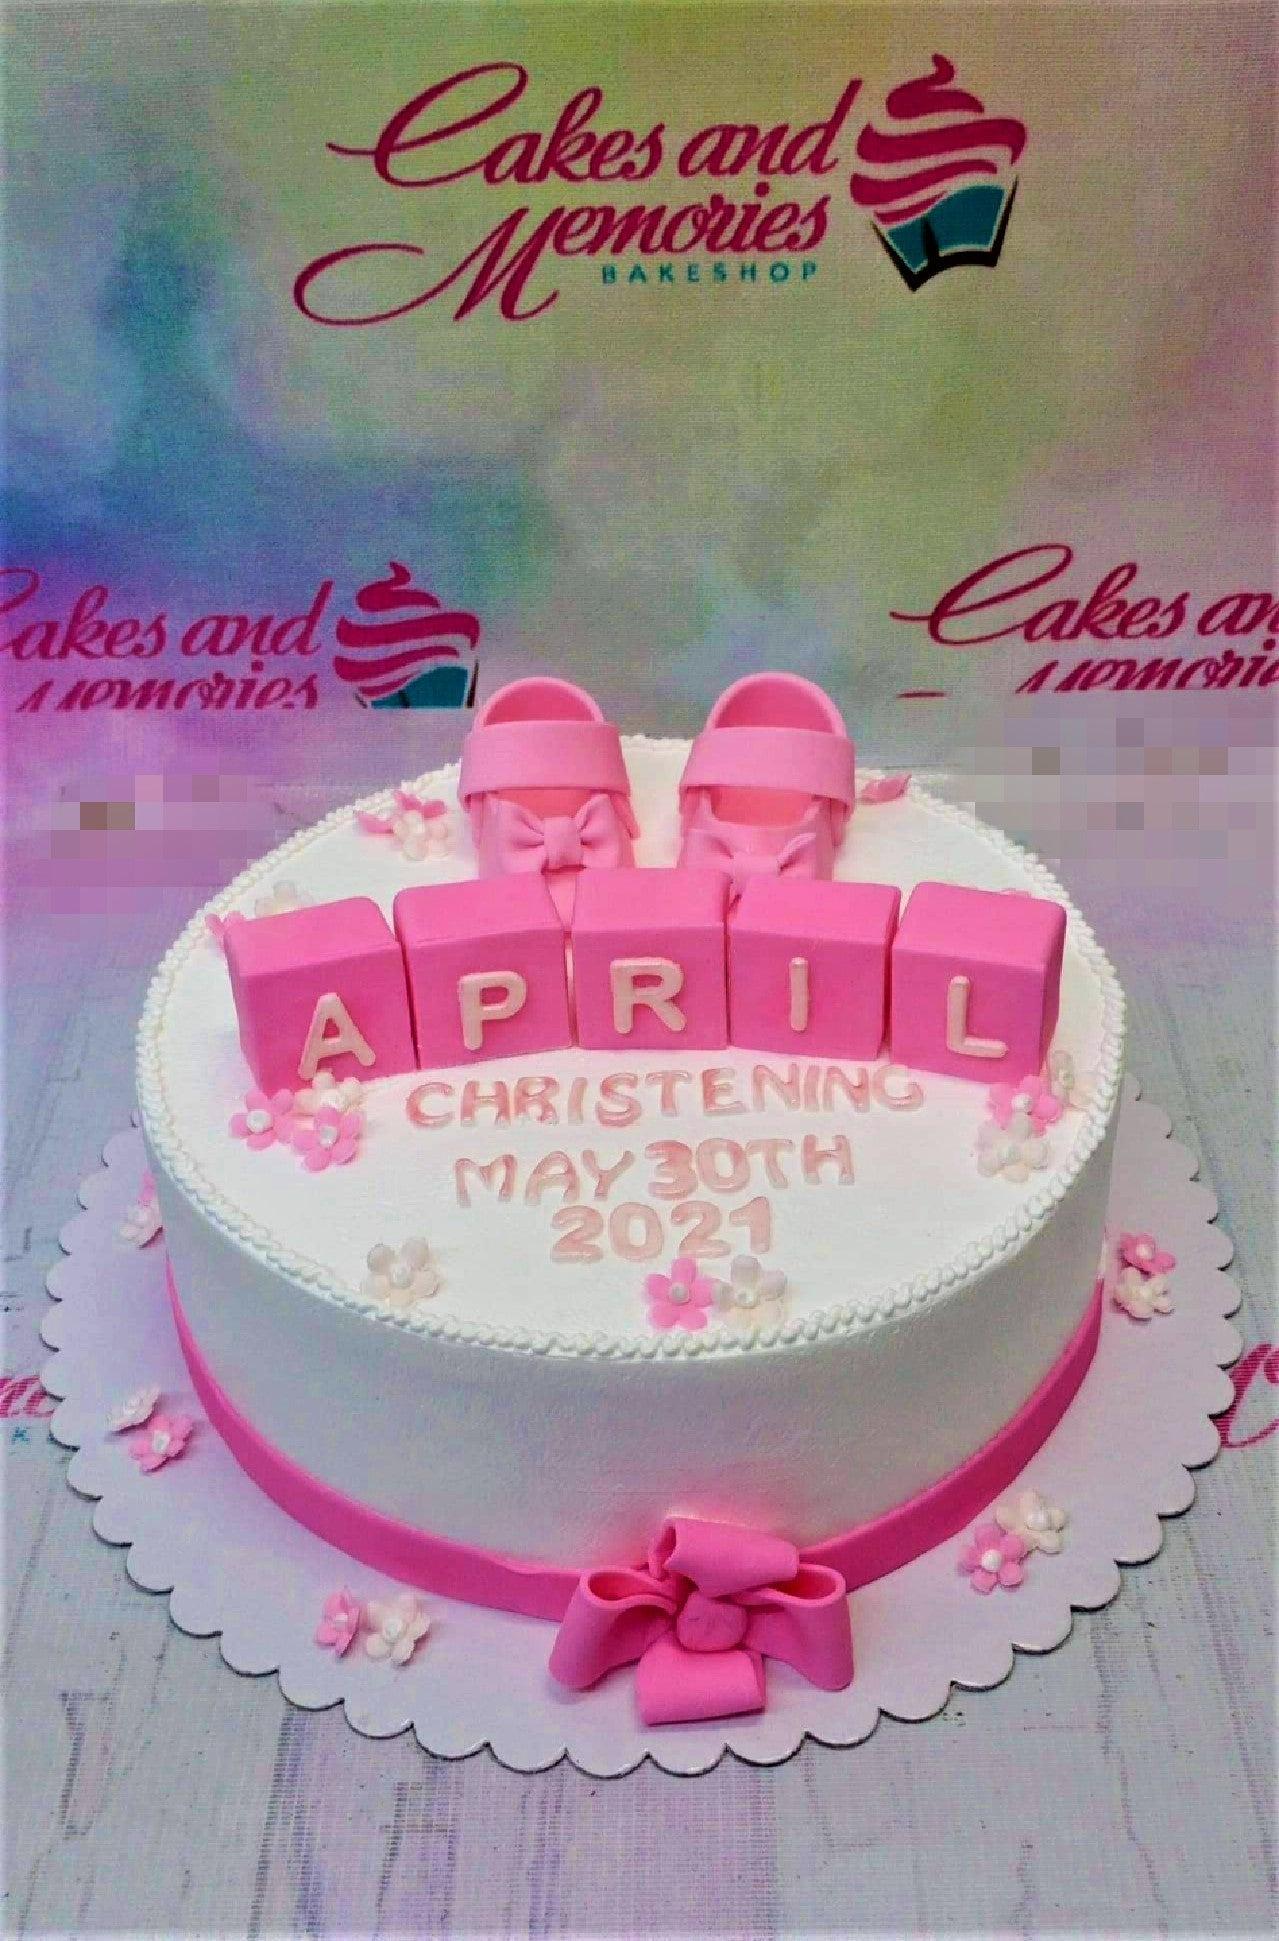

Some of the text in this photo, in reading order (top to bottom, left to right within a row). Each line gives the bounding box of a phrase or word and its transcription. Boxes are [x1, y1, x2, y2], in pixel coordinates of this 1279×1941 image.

[326, 61, 863, 187] Cakes and
[293, 181, 832, 325] Memories
[601, 260, 819, 285] BAKESHOP
[181, 580, 334, 657] and
[889, 544, 1191, 645] Cakes
[299, 956, 1008, 1079] APRIL
[405, 1063, 925, 1128] CHRISTENING
[453, 1134, 856, 1207] MAY 30TH
[550, 1196, 773, 1263] 2021
